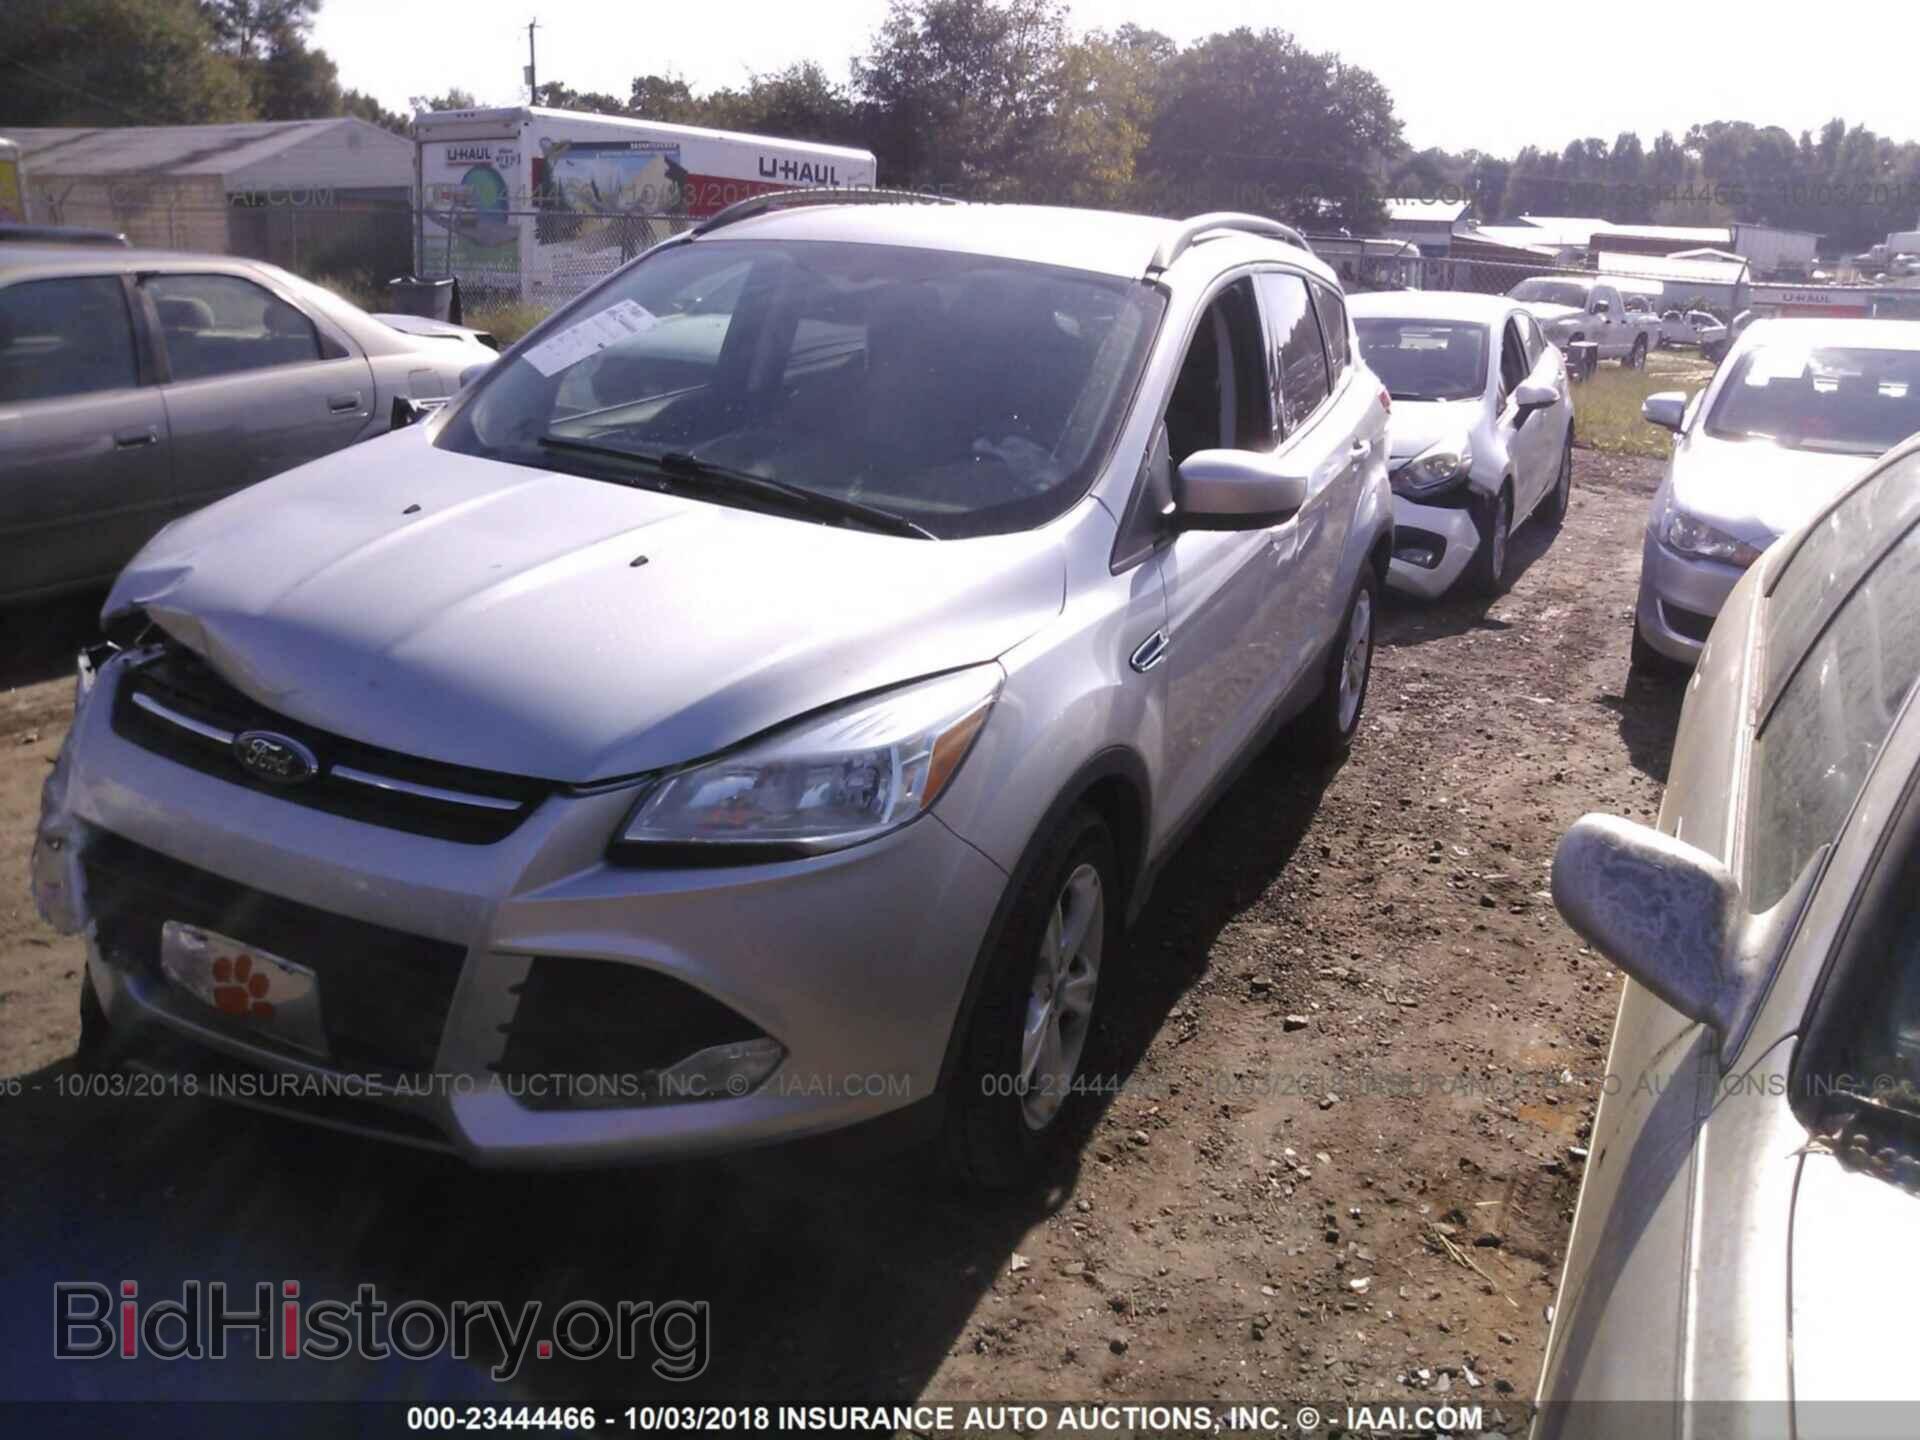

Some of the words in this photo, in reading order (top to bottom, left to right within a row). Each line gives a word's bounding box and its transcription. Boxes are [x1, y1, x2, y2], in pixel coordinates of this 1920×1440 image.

[447, 147, 492, 160] U-HAUL
[758, 156, 840, 186] U-HAUL
[245, 738, 294, 777] Ford
